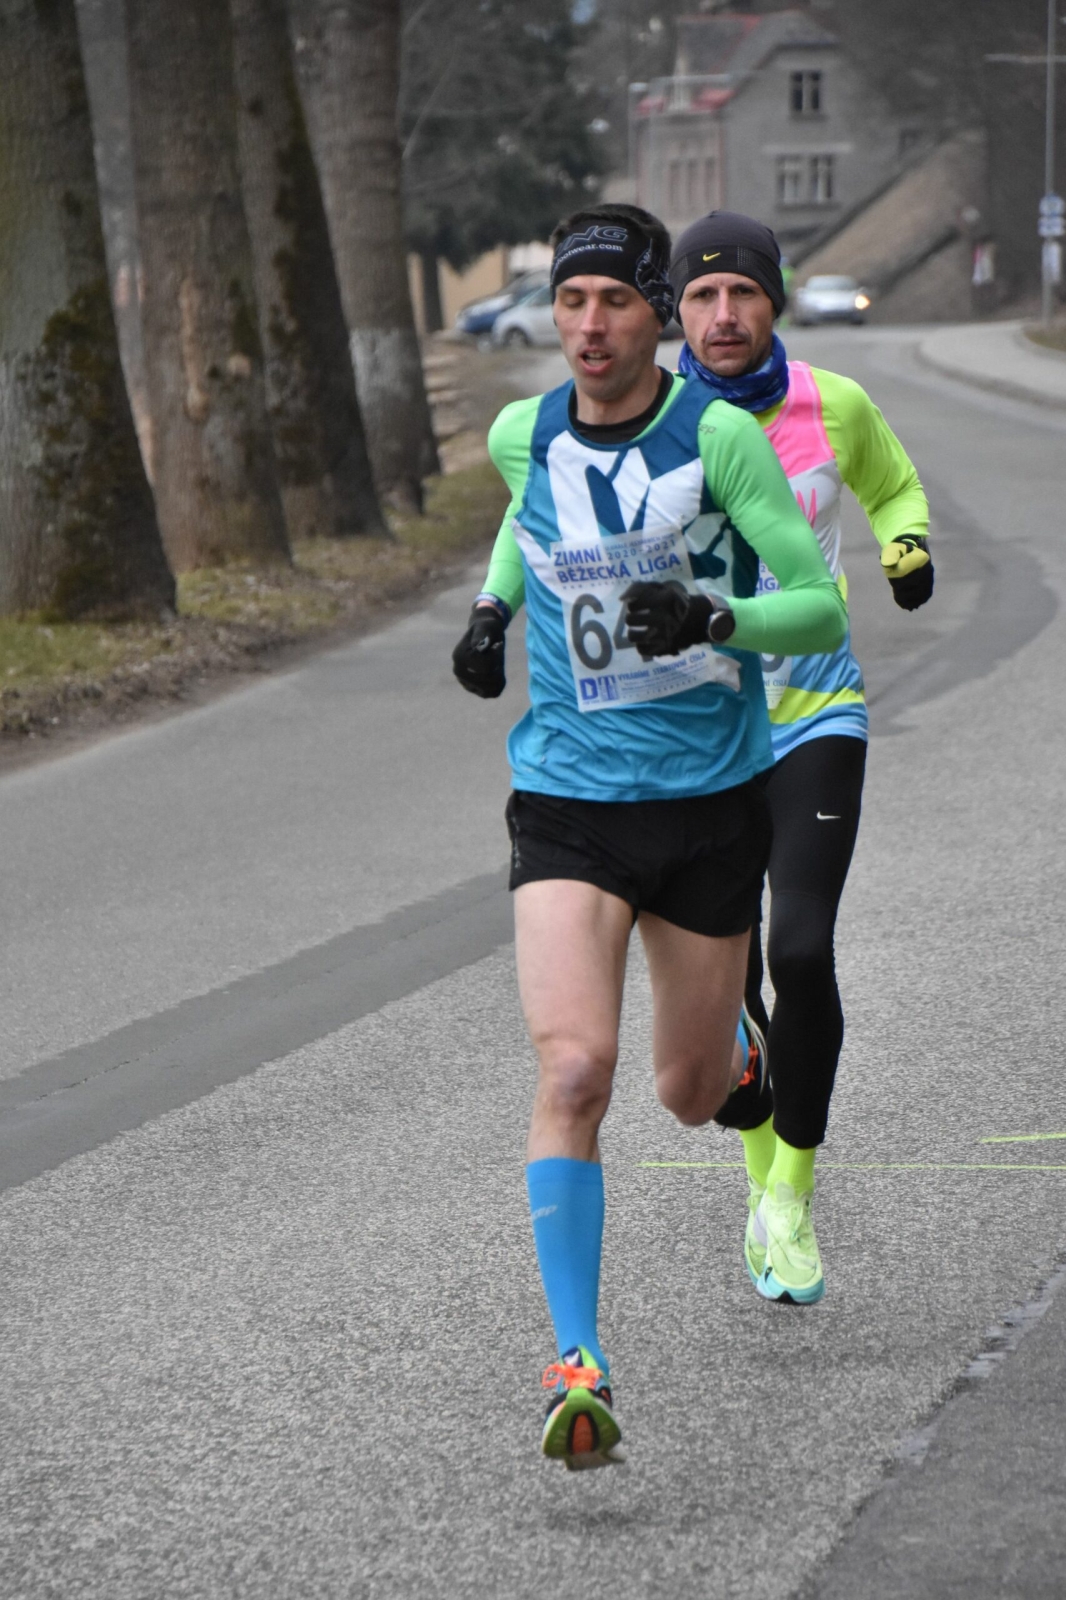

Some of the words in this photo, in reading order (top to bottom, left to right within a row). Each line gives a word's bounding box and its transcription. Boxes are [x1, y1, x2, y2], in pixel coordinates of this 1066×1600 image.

[554, 545, 603, 567] ZIMNÍ
[556, 560, 632, 583] BĚŽECKÁ
[637, 552, 682, 575] LIGA
